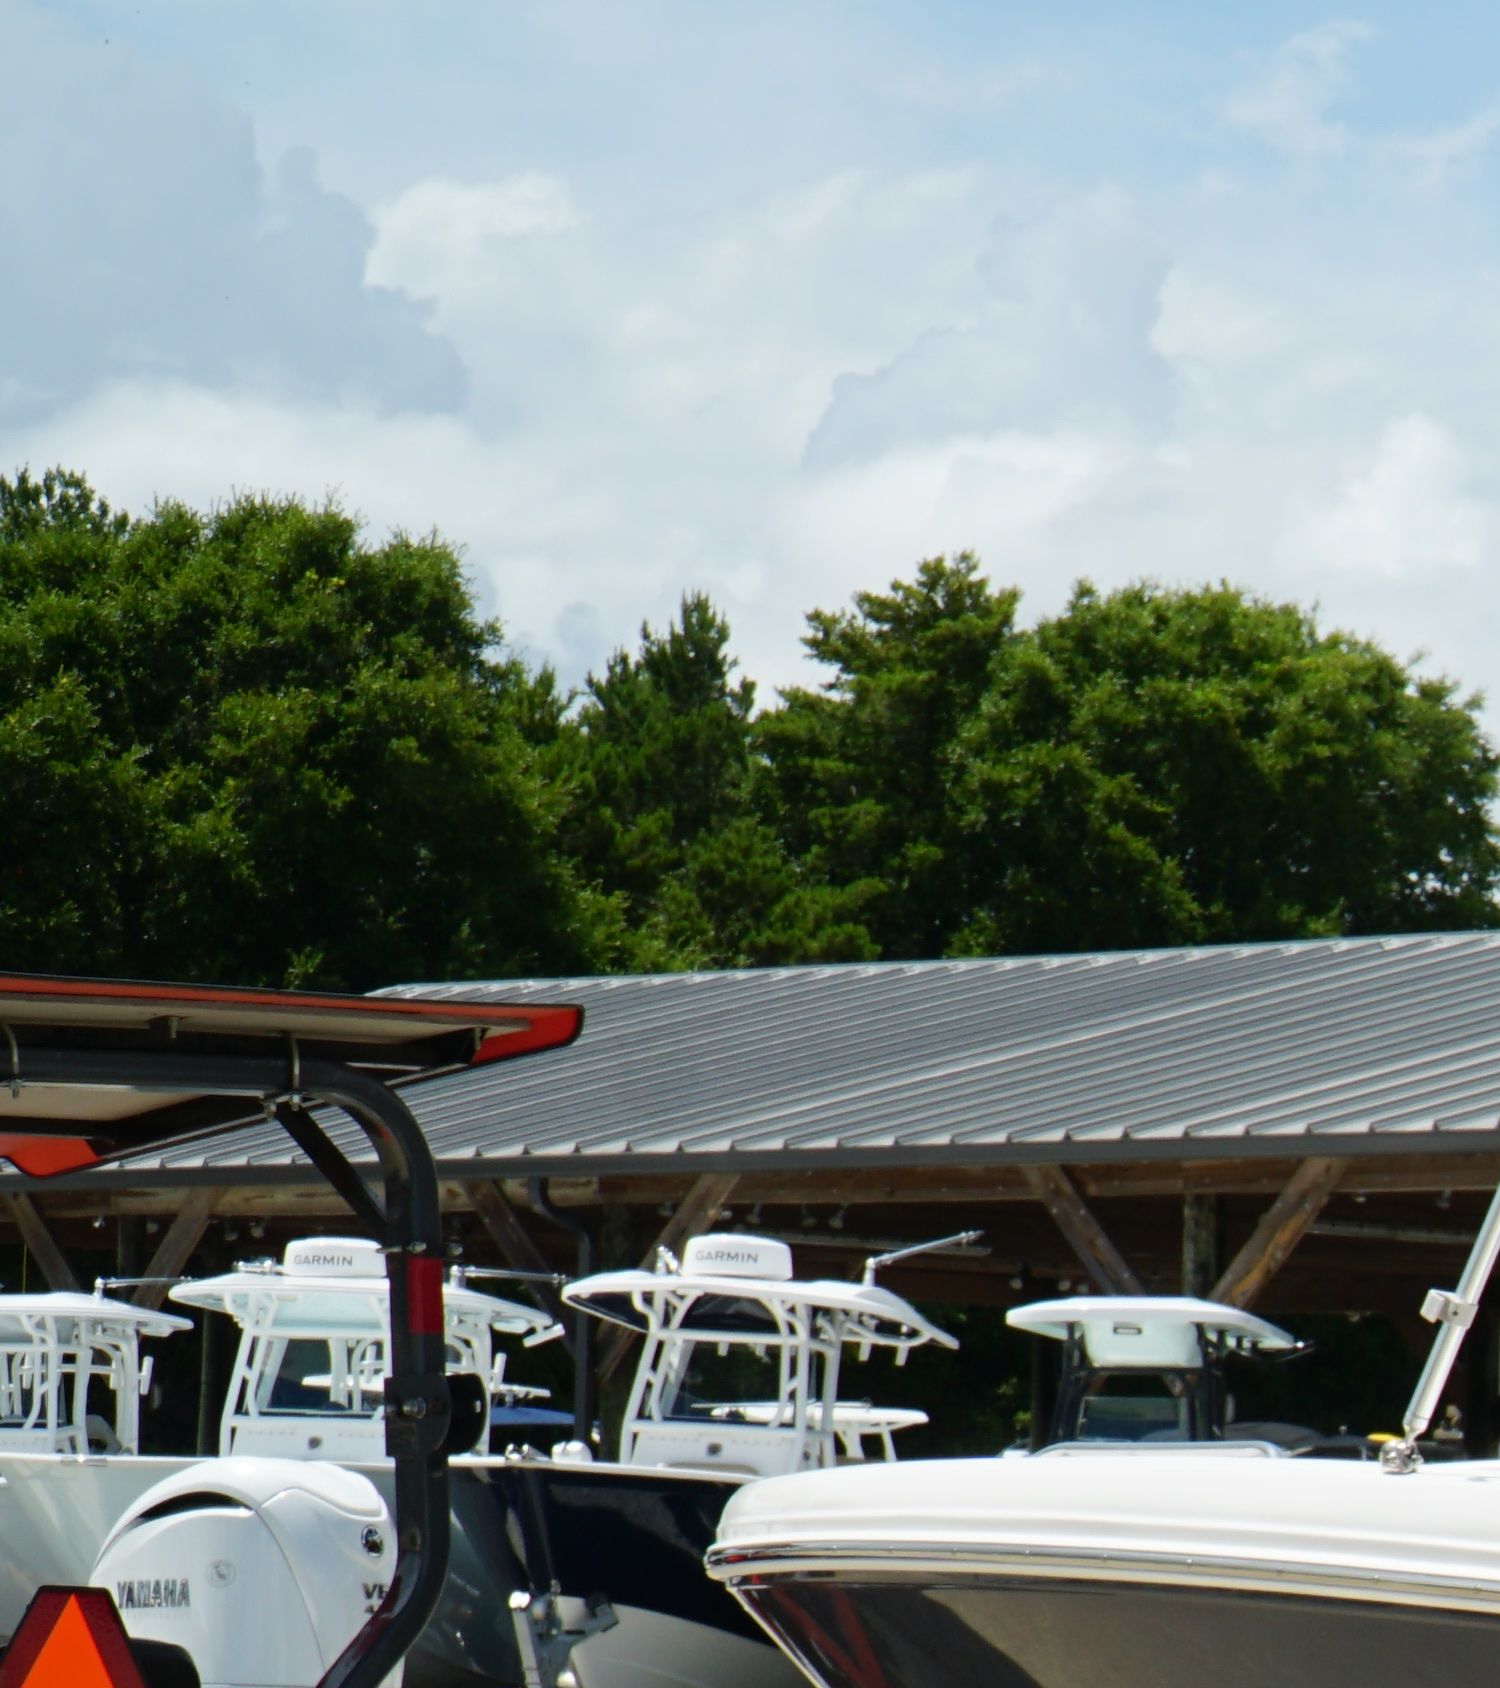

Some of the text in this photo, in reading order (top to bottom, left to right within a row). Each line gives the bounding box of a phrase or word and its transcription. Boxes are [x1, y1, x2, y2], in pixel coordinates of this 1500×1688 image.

[294, 1254, 353, 1265] GARMIN
[694, 1250, 759, 1263] GARMIN
[117, 1579, 190, 1608] YAMAHA
